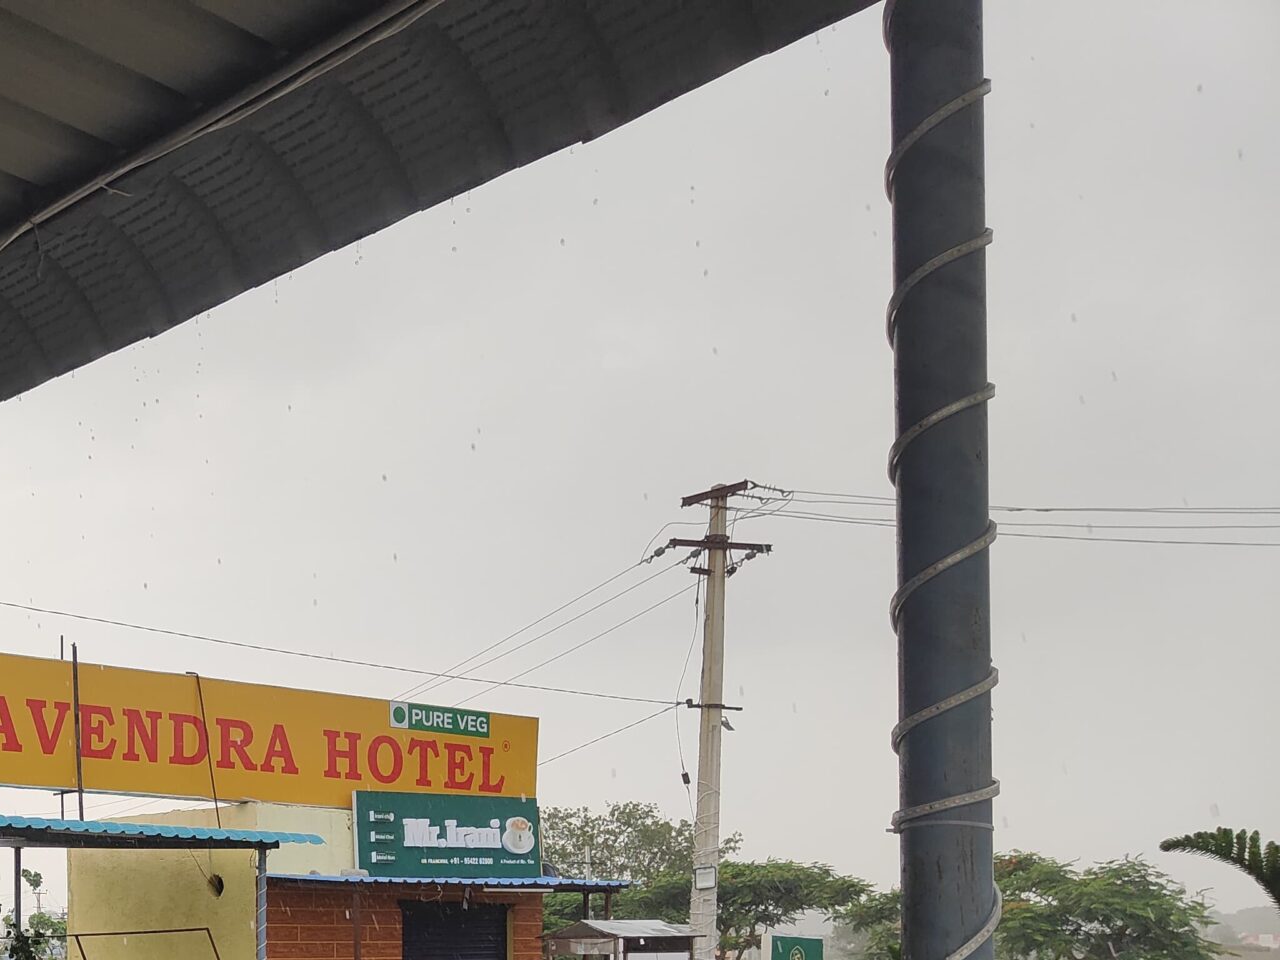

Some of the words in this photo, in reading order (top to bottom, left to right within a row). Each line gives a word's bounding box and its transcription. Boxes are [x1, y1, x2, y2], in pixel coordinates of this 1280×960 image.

[411, 709, 453, 729] PURE
[456, 714, 488, 733] VEG
[324, 730, 505, 793] HOTEL
